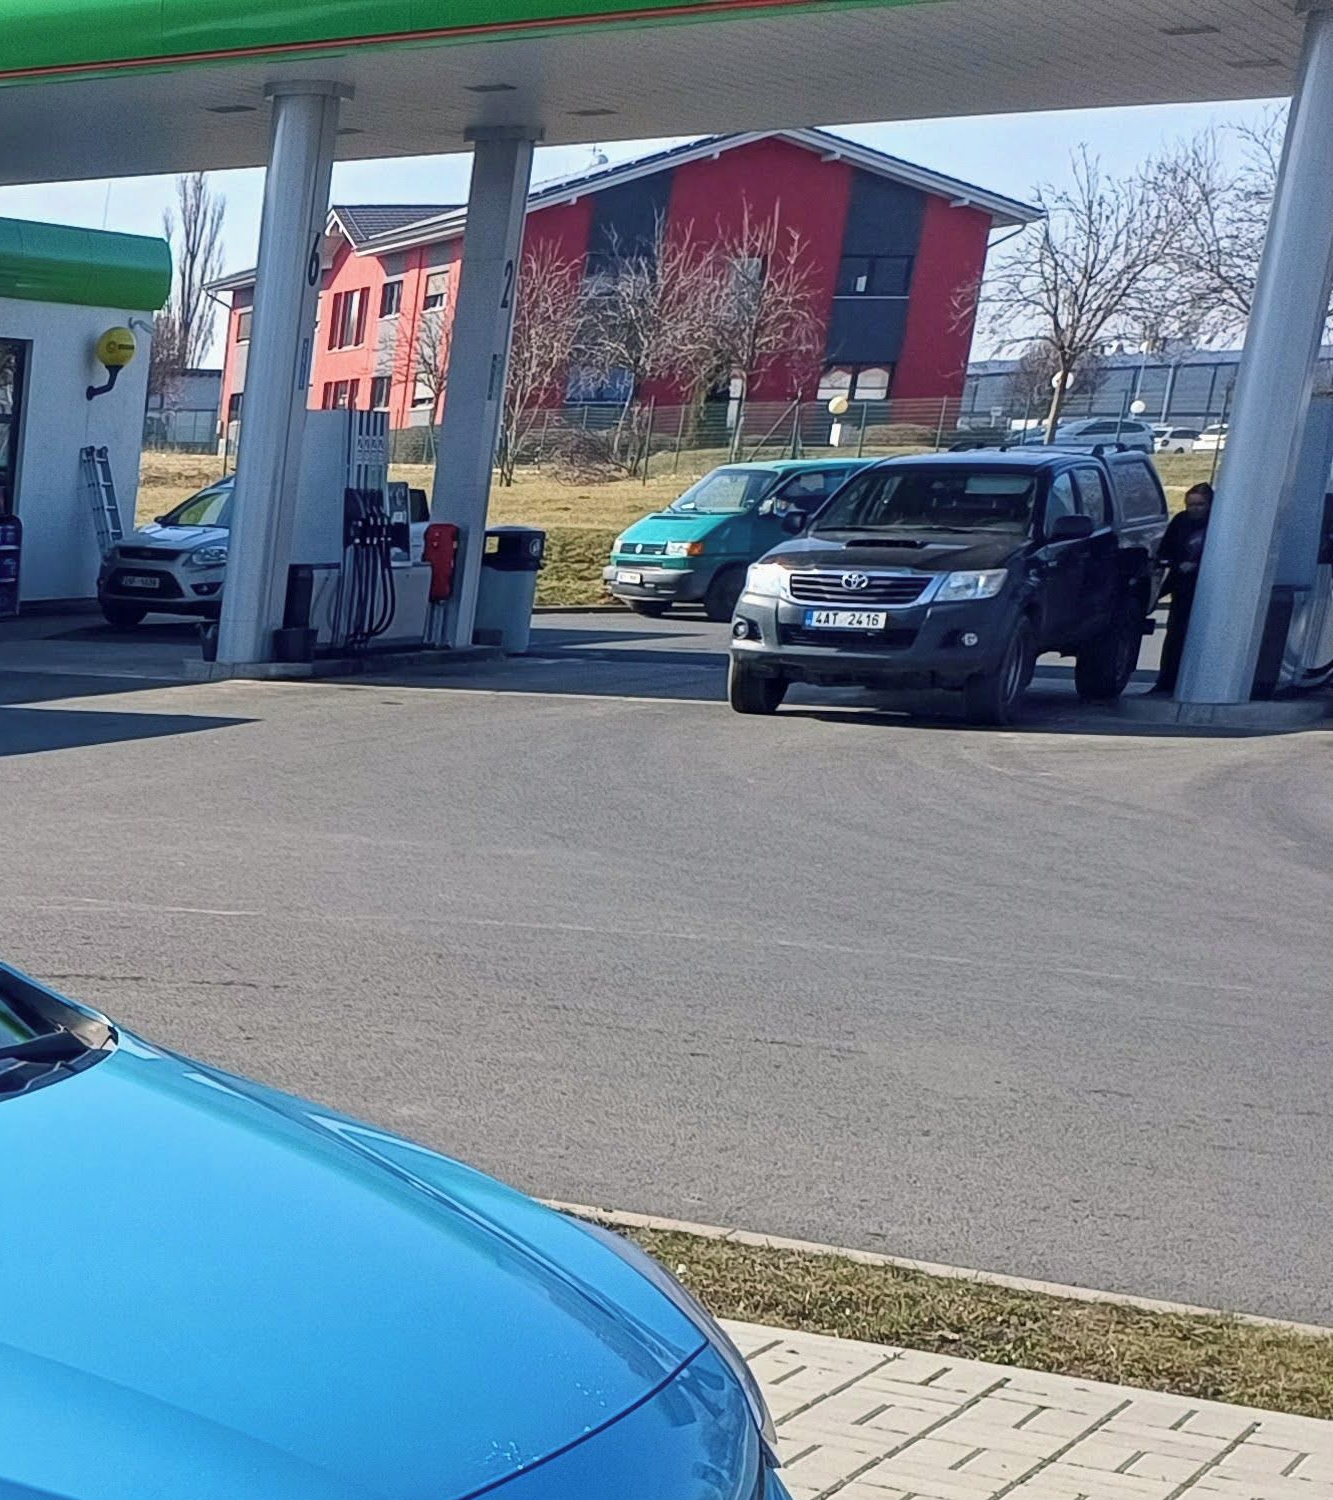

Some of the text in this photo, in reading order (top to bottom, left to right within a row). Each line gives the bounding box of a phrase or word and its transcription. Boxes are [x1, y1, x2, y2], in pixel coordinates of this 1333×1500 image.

[308, 232, 321, 287] 6
[500, 260, 513, 309] 2
[815, 611, 880, 627] 4AT 2416
